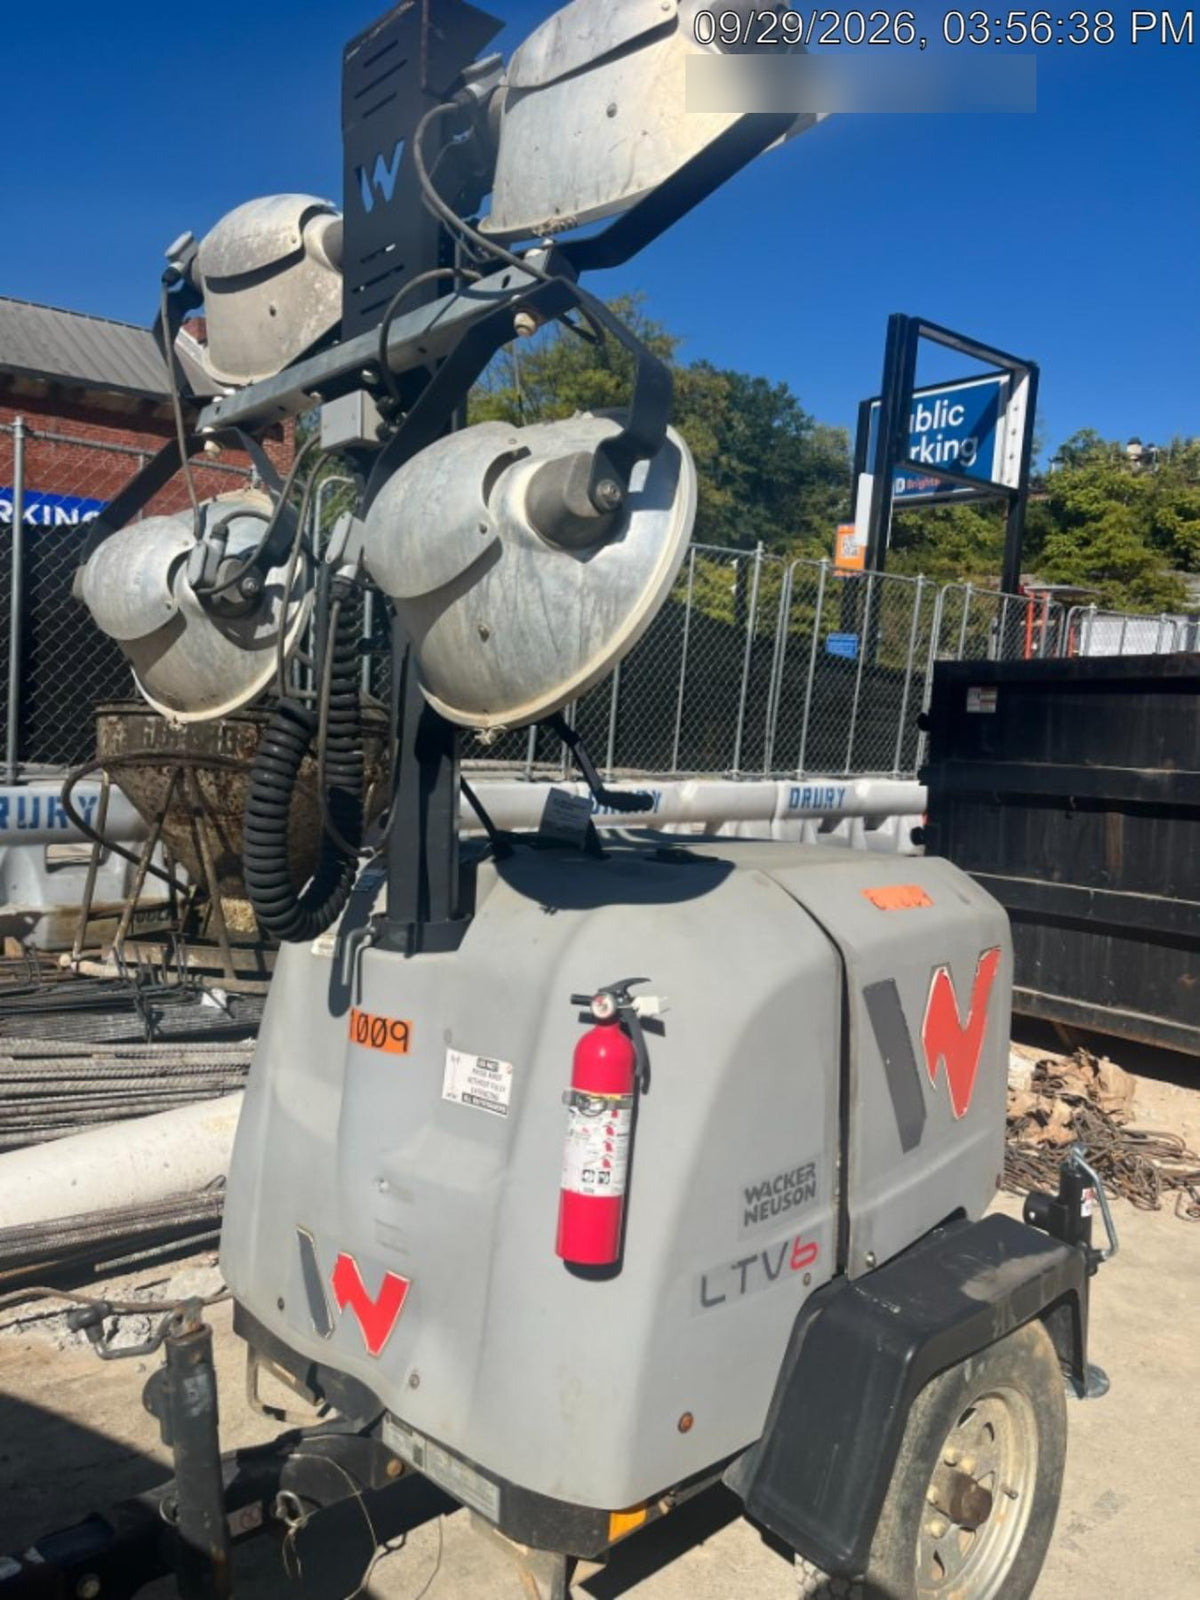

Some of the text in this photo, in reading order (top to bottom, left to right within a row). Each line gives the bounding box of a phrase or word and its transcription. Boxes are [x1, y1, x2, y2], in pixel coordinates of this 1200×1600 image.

[910, 399, 965, 433] blic
[910, 434, 979, 467] rking
[788, 787, 846, 809] DRURY
[350, 1009, 408, 1052] 1009
[744, 1162, 816, 1205] WACKER
[744, 1181, 816, 1227] NEUSON
[701, 1234, 819, 1308] LTV6
